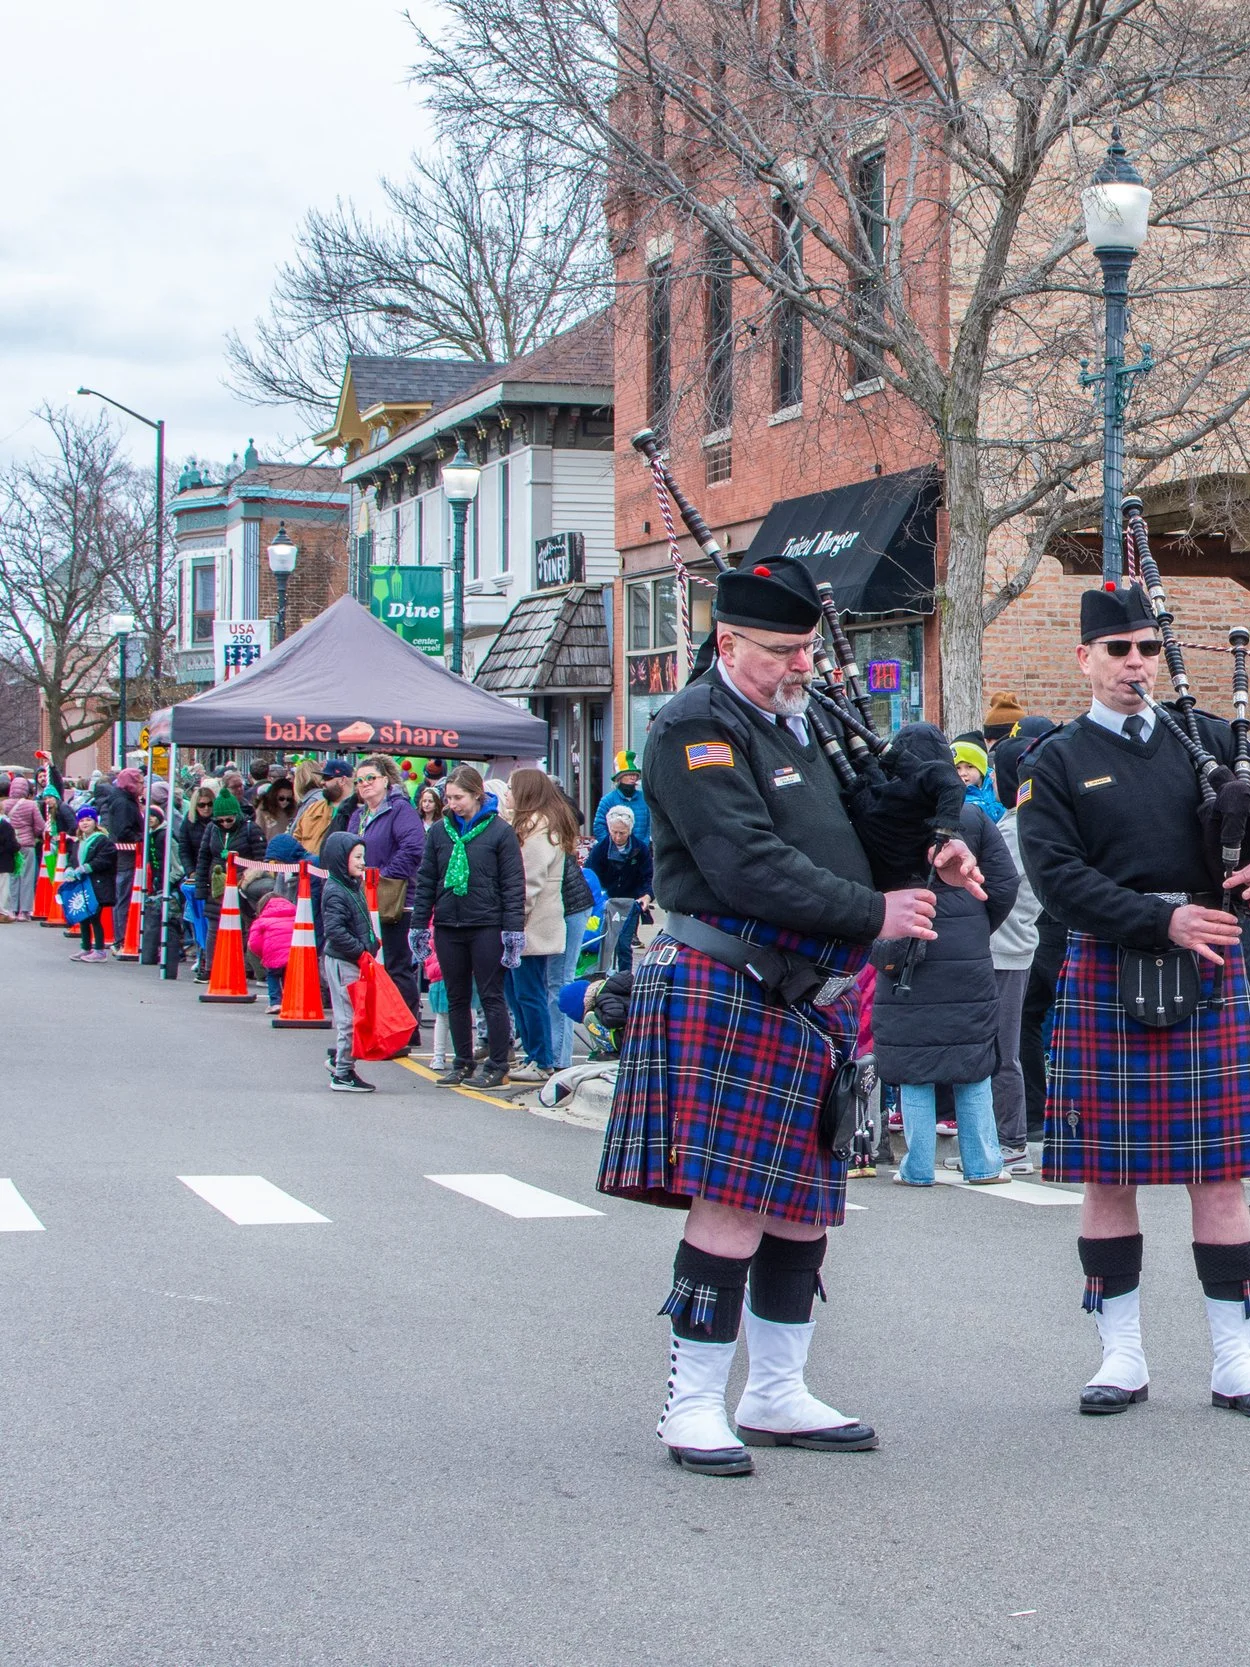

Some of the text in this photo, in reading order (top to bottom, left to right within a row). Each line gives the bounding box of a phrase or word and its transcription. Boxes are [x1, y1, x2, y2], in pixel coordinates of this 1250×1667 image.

[813, 530, 860, 558] Burger
[543, 556, 568, 583] DINER
[387, 601, 441, 619] Dine
[229, 623, 255, 635] USA
[232, 634, 253, 644] 250
[412, 637, 440, 646] center
[415, 643, 441, 652] ourself
[871, 662, 897, 689] OPEN
[263, 713, 460, 748] bake share
